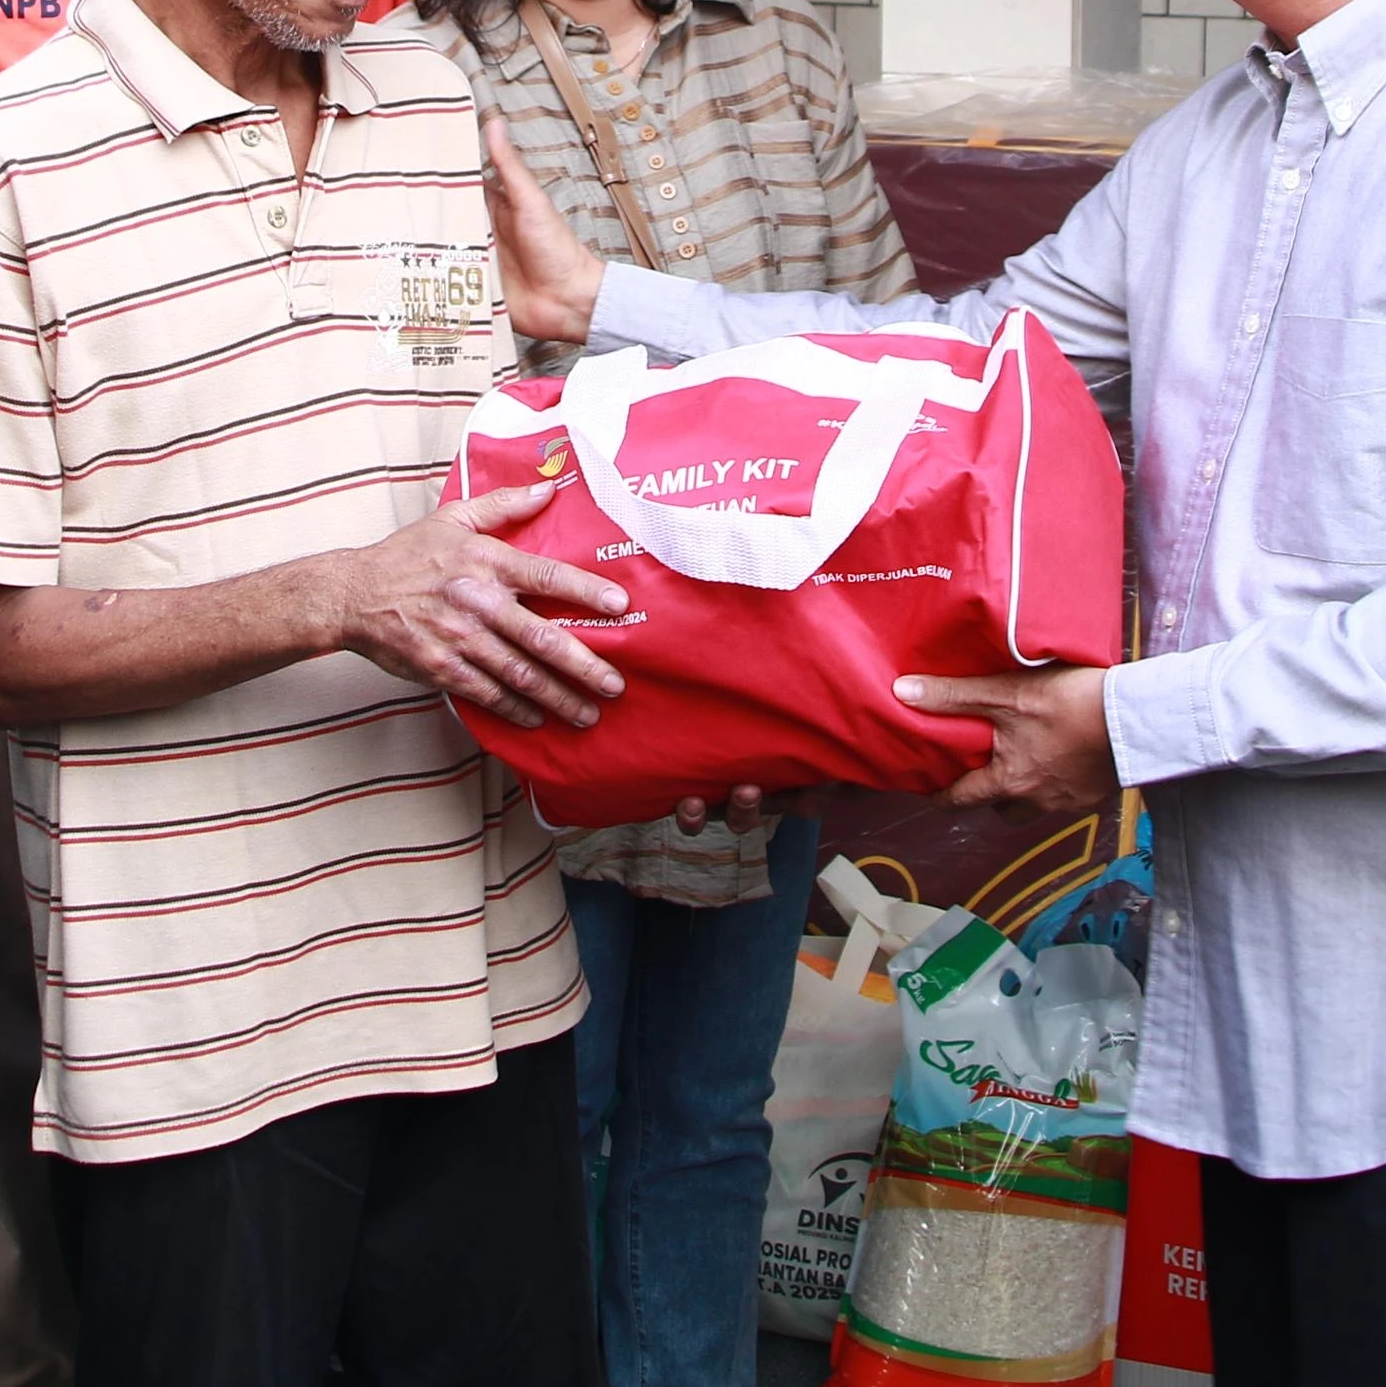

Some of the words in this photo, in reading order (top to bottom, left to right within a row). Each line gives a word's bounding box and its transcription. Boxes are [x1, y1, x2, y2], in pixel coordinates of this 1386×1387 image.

[448, 267, 483, 306] 69
[623, 459, 736, 499] FAMILY
[742, 458, 800, 483] KIT
[812, 572, 844, 587] TIDAK
[761, 1240, 812, 1264] OSIAL
[816, 1248, 852, 1271] PRO
[758, 1260, 819, 1286] ANTAN
[790, 1284, 842, 1301] 2025
